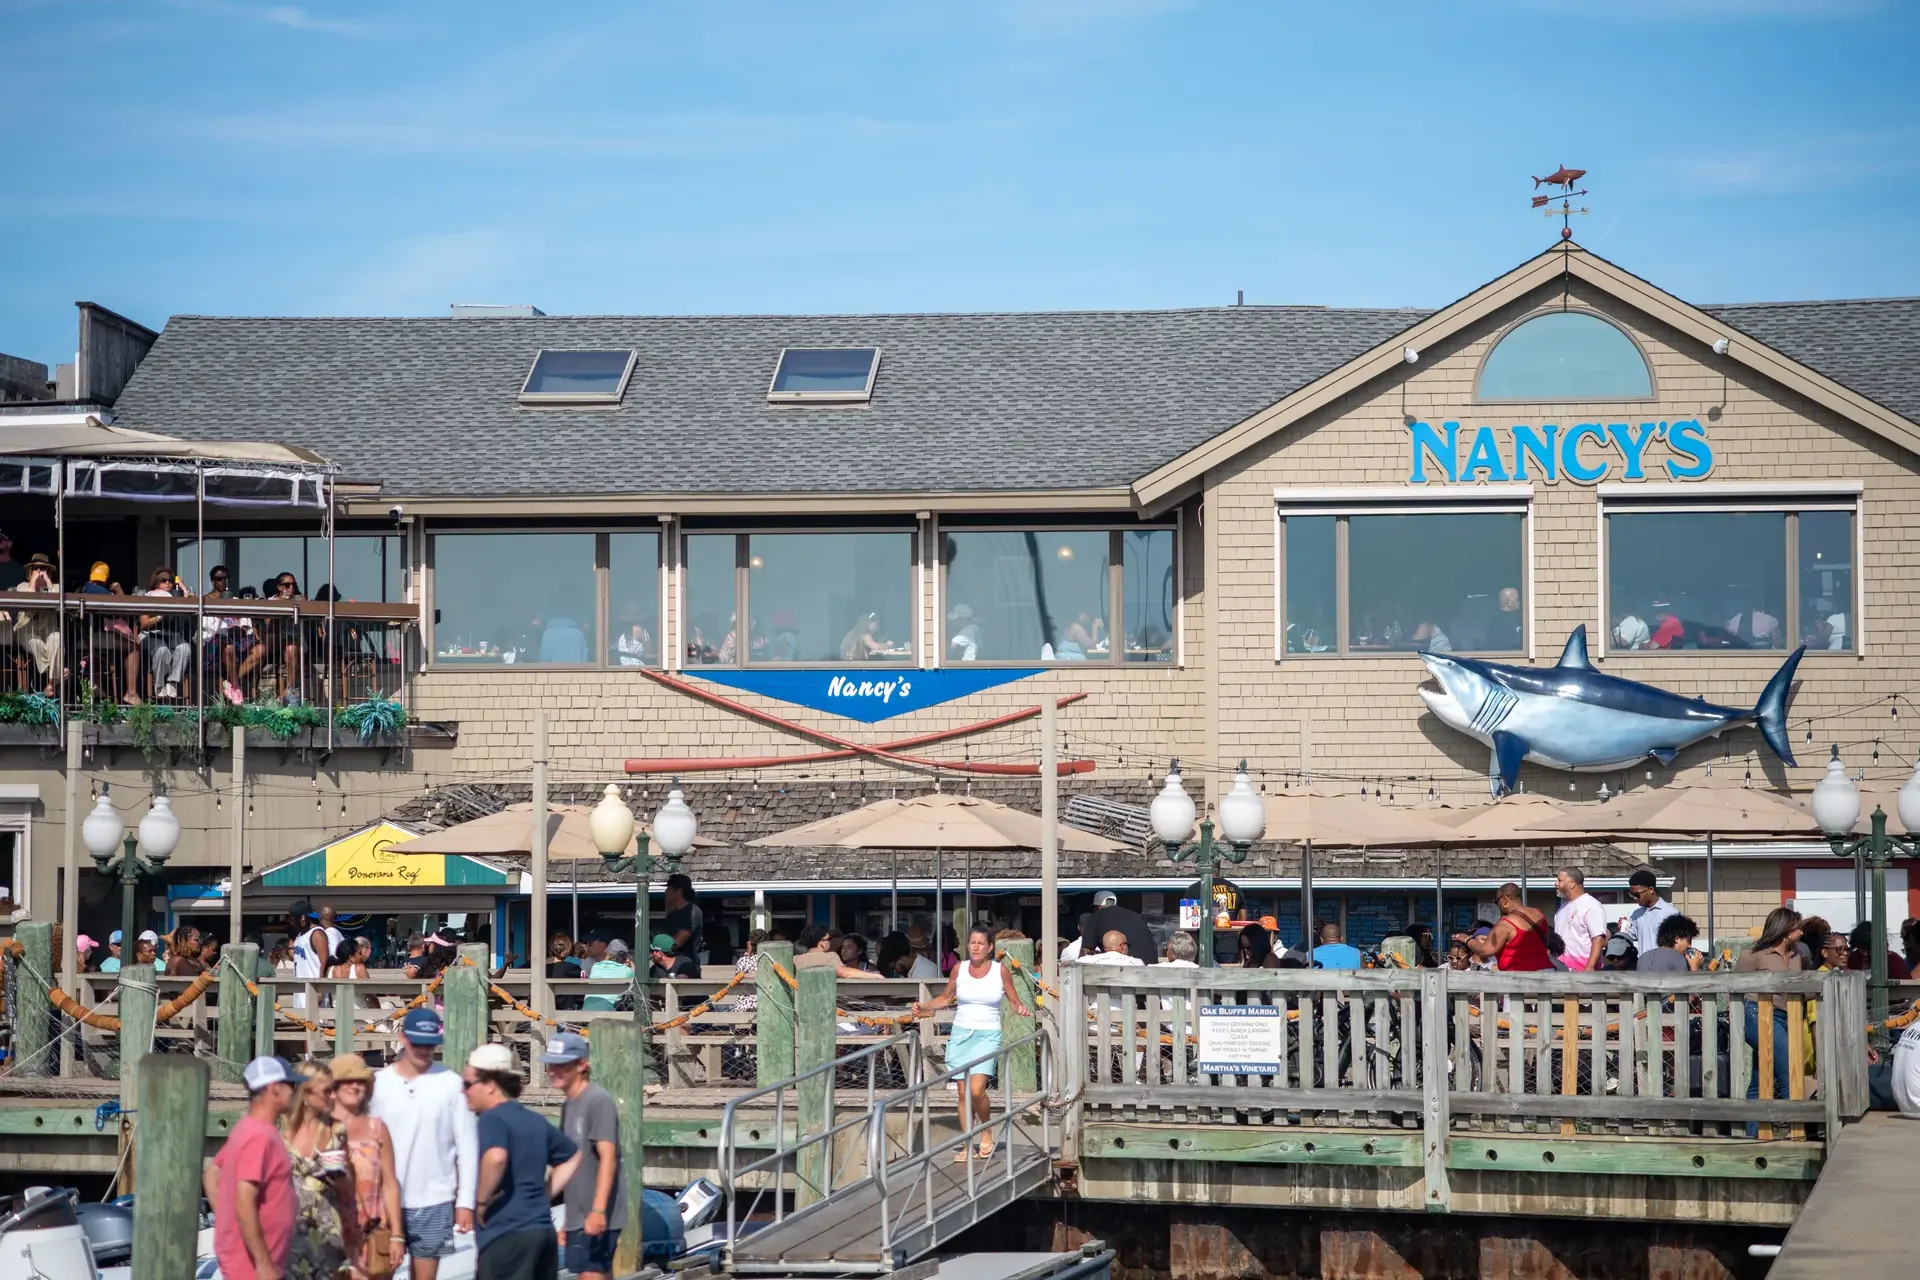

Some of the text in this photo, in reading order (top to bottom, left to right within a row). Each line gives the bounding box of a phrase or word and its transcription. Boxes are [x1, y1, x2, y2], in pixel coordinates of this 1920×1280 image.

[1408, 419, 1713, 482] NANCY'S
[827, 675, 912, 704] Nancy's
[397, 866, 421, 884] Reef
[1201, 1007, 1277, 1016] OAK BLUFFS MARINA
[1203, 1064, 1277, 1072] MARTHA'S VINEYARD
